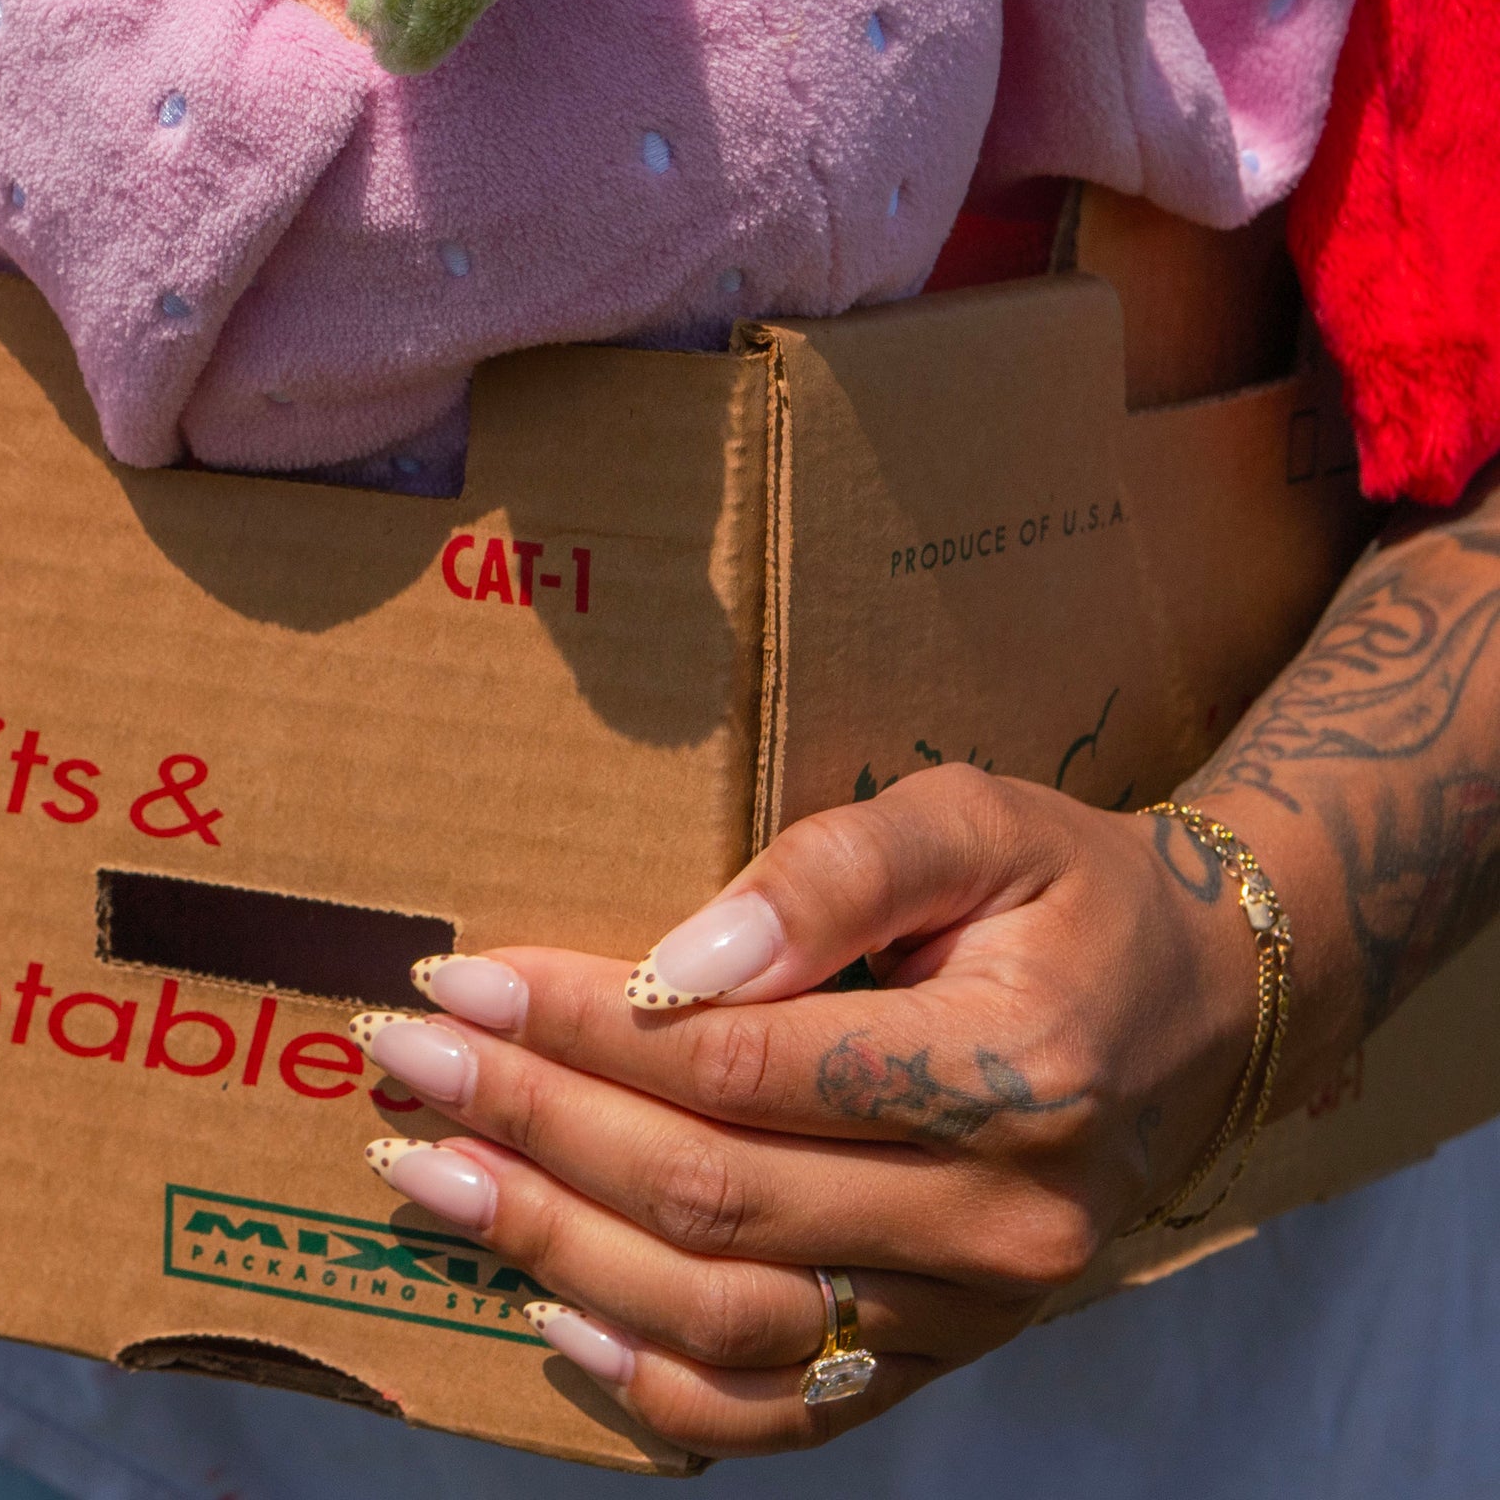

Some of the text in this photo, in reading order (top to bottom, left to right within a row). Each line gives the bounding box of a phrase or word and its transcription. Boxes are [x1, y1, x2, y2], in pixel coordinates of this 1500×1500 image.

[441, 534, 592, 614] CAT-1
[890, 524, 1007, 578] PRODUCE
[1018, 514, 1050, 547] OF
[128, 752, 225, 848] &
[190, 1243, 417, 1303] PACKAGING
